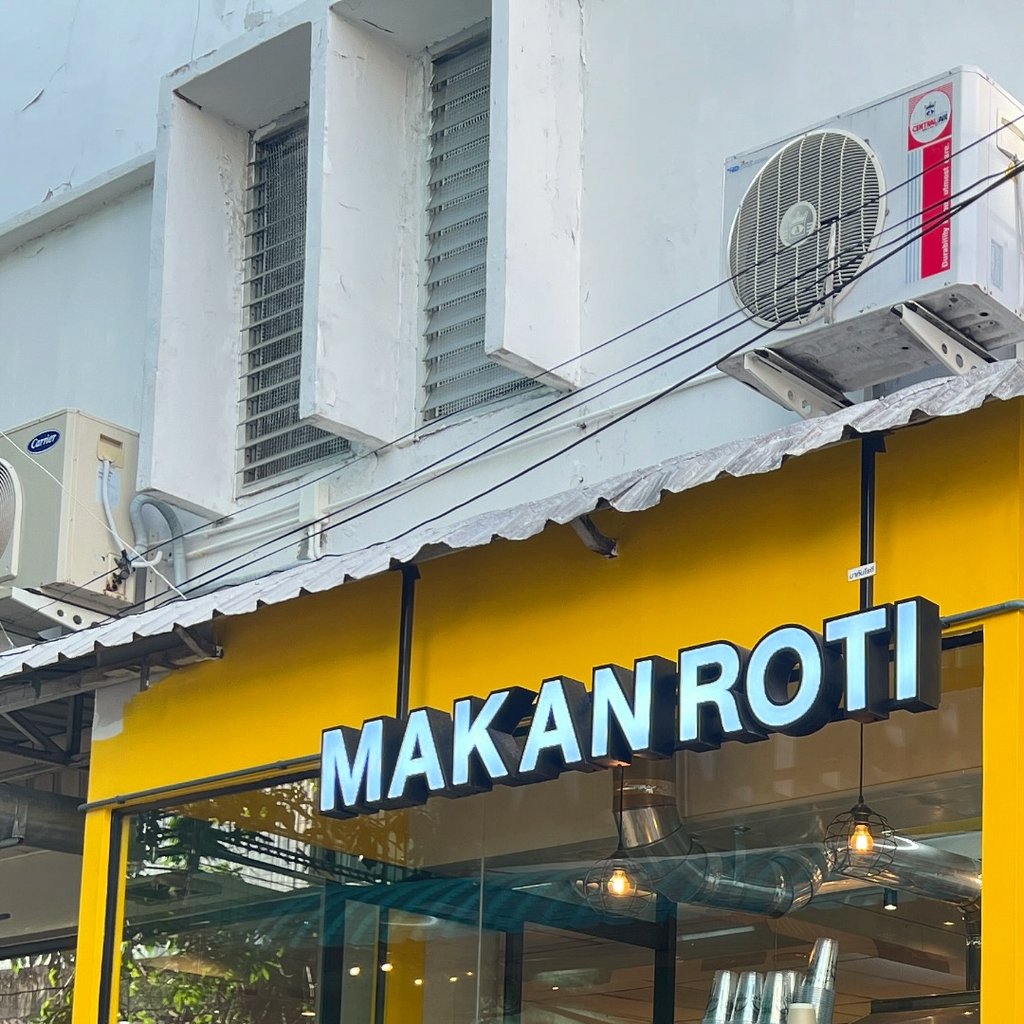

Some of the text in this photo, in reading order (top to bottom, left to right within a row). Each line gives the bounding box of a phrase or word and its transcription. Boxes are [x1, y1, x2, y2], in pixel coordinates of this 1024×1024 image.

[941, 227, 949, 268] Durability
[30, 433, 57, 449] Carrier
[319, 600, 921, 813] MAKAN ROTI
